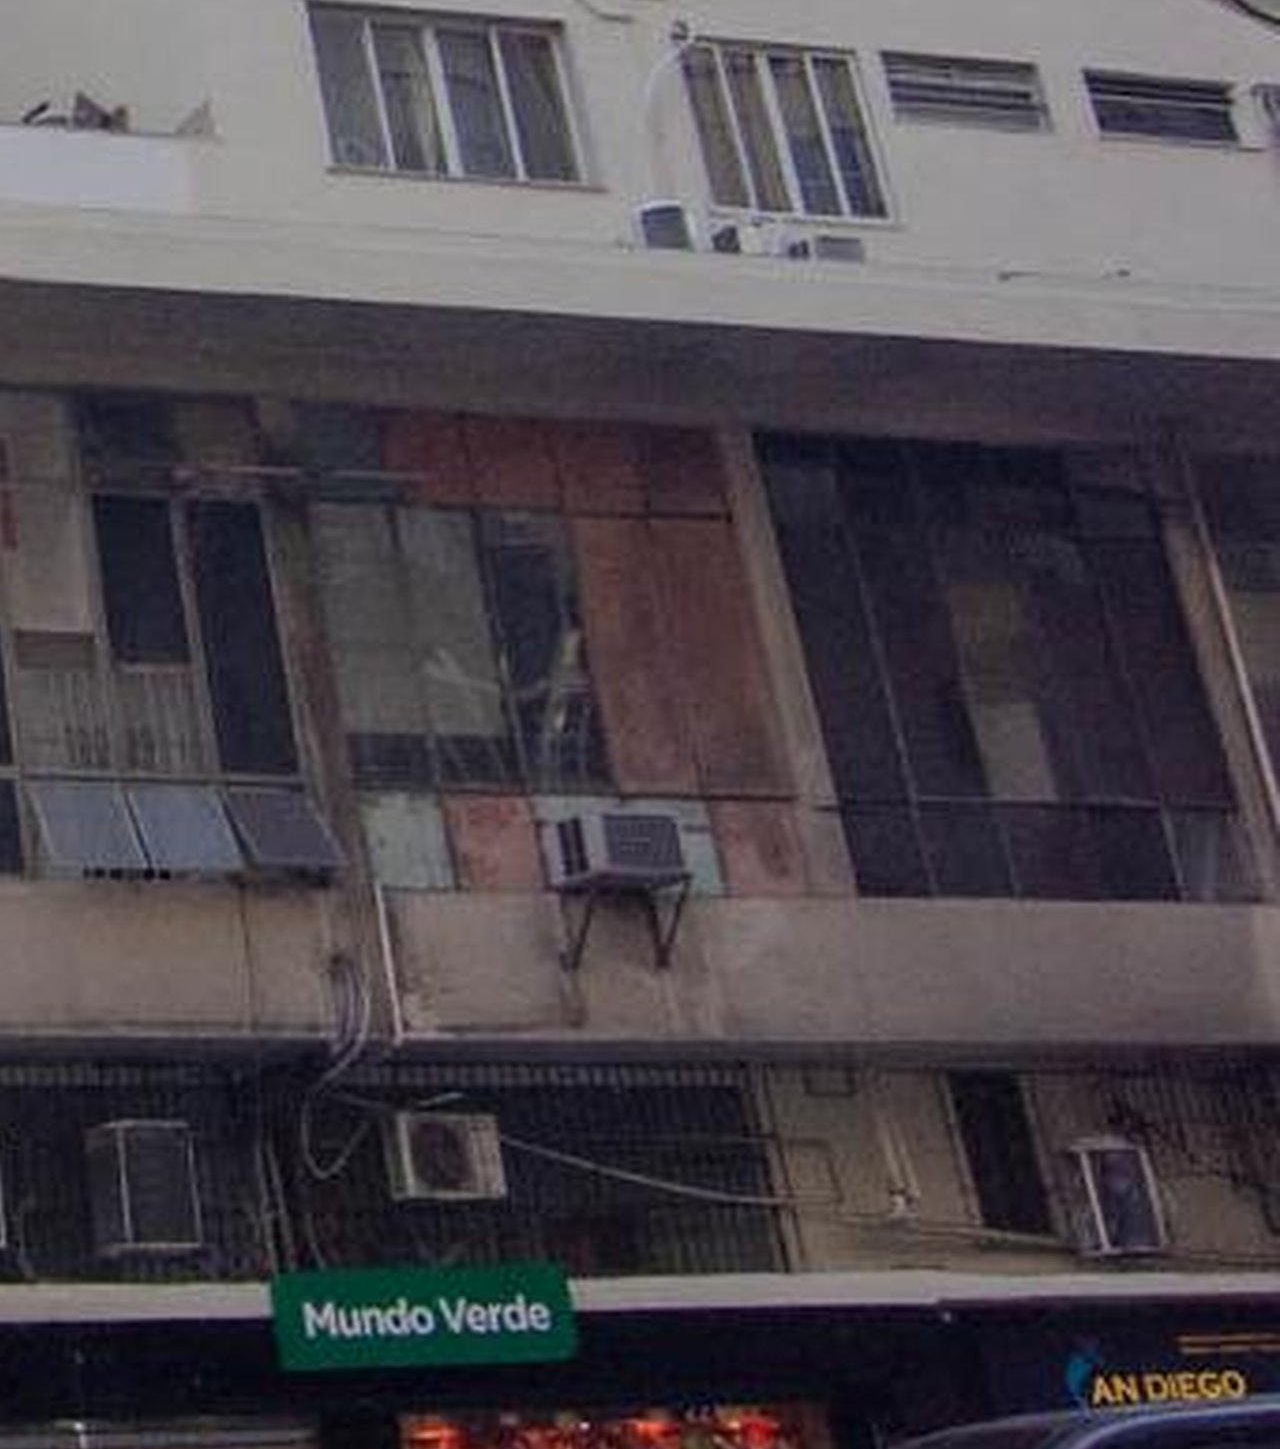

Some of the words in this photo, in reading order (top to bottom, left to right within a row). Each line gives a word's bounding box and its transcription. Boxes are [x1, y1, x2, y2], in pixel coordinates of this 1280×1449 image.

[303, 1299, 434, 1338] Mundo
[439, 1293, 551, 1333] Verde
[1144, 1370, 1245, 1400] DIEGO
